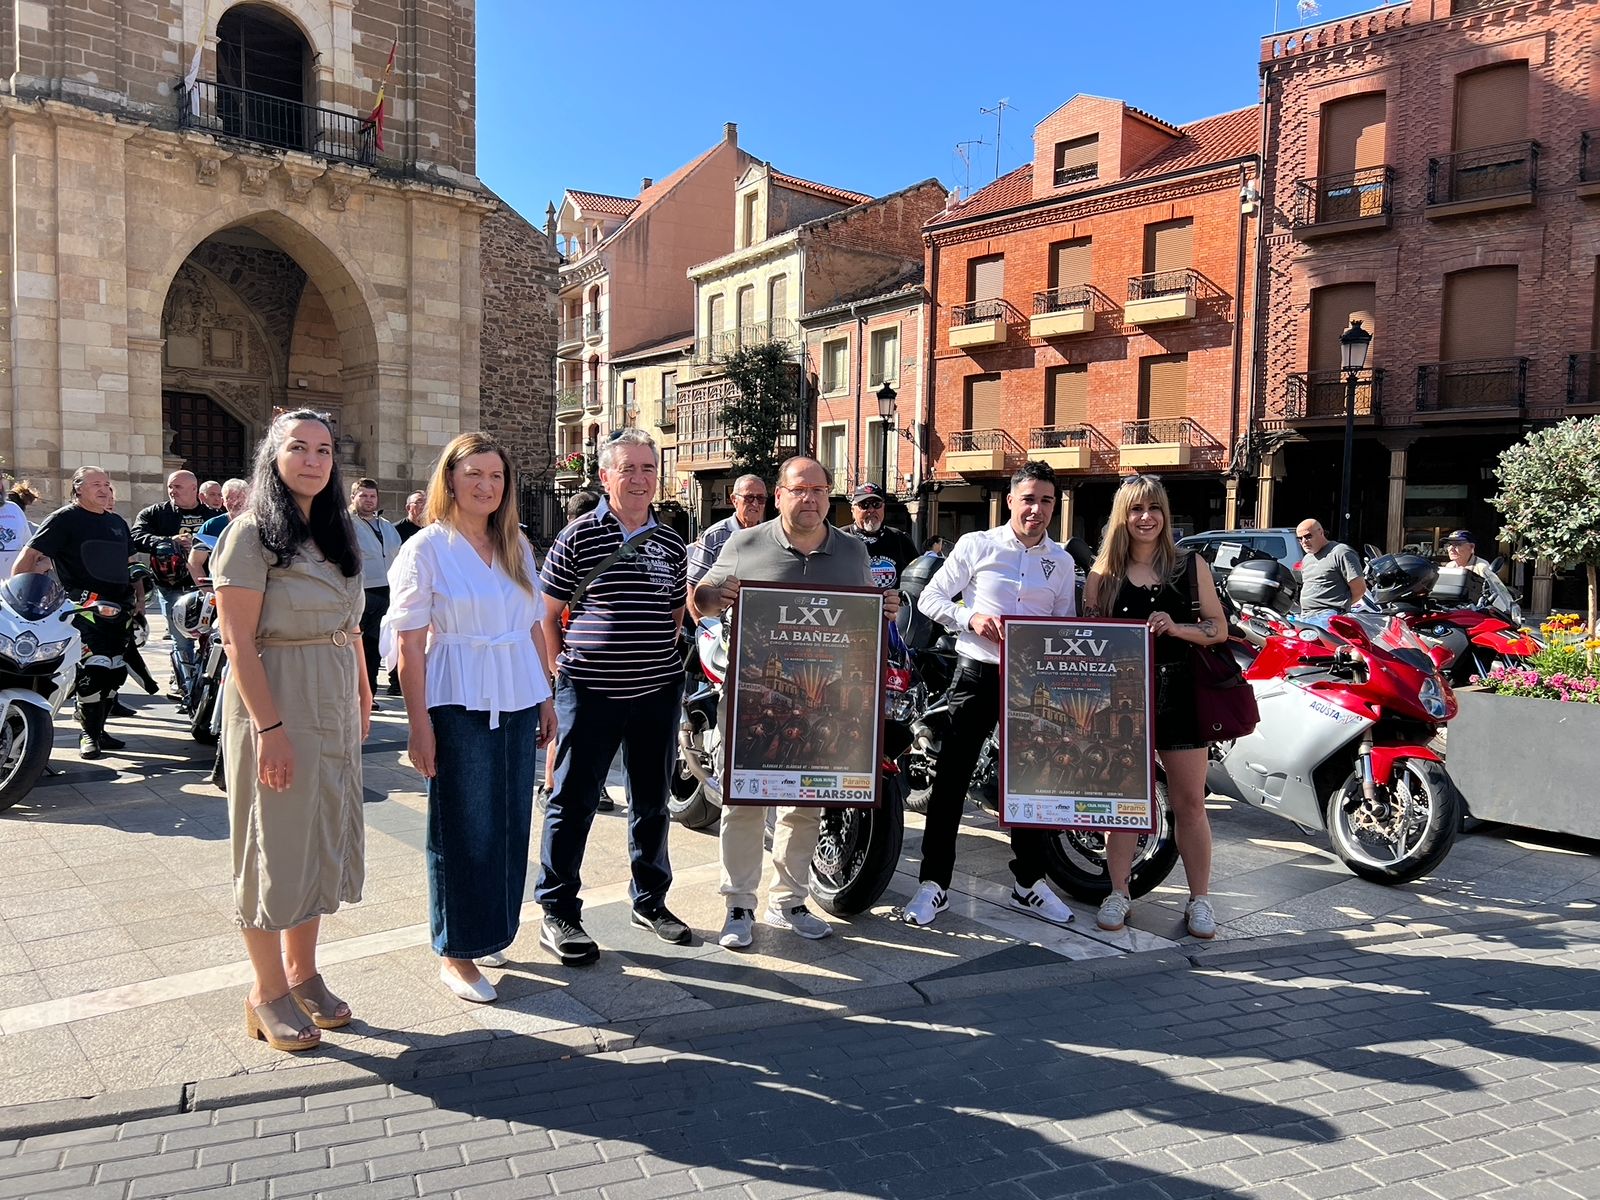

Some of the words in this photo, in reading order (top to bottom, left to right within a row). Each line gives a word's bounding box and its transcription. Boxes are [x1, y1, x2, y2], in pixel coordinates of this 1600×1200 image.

[778, 605, 844, 627] LXV
[770, 630, 789, 641] LA
[792, 630, 851, 643] BAÑEZA
[1043, 637, 1109, 657] LXV
[1036, 660, 1055, 671] LA
[1059, 660, 1117, 673] BAÑEZA
[1310, 701, 1340, 720] AGUSTA
[816, 789, 872, 799] LARSSON
[1091, 815, 1149, 826] LARSSON
